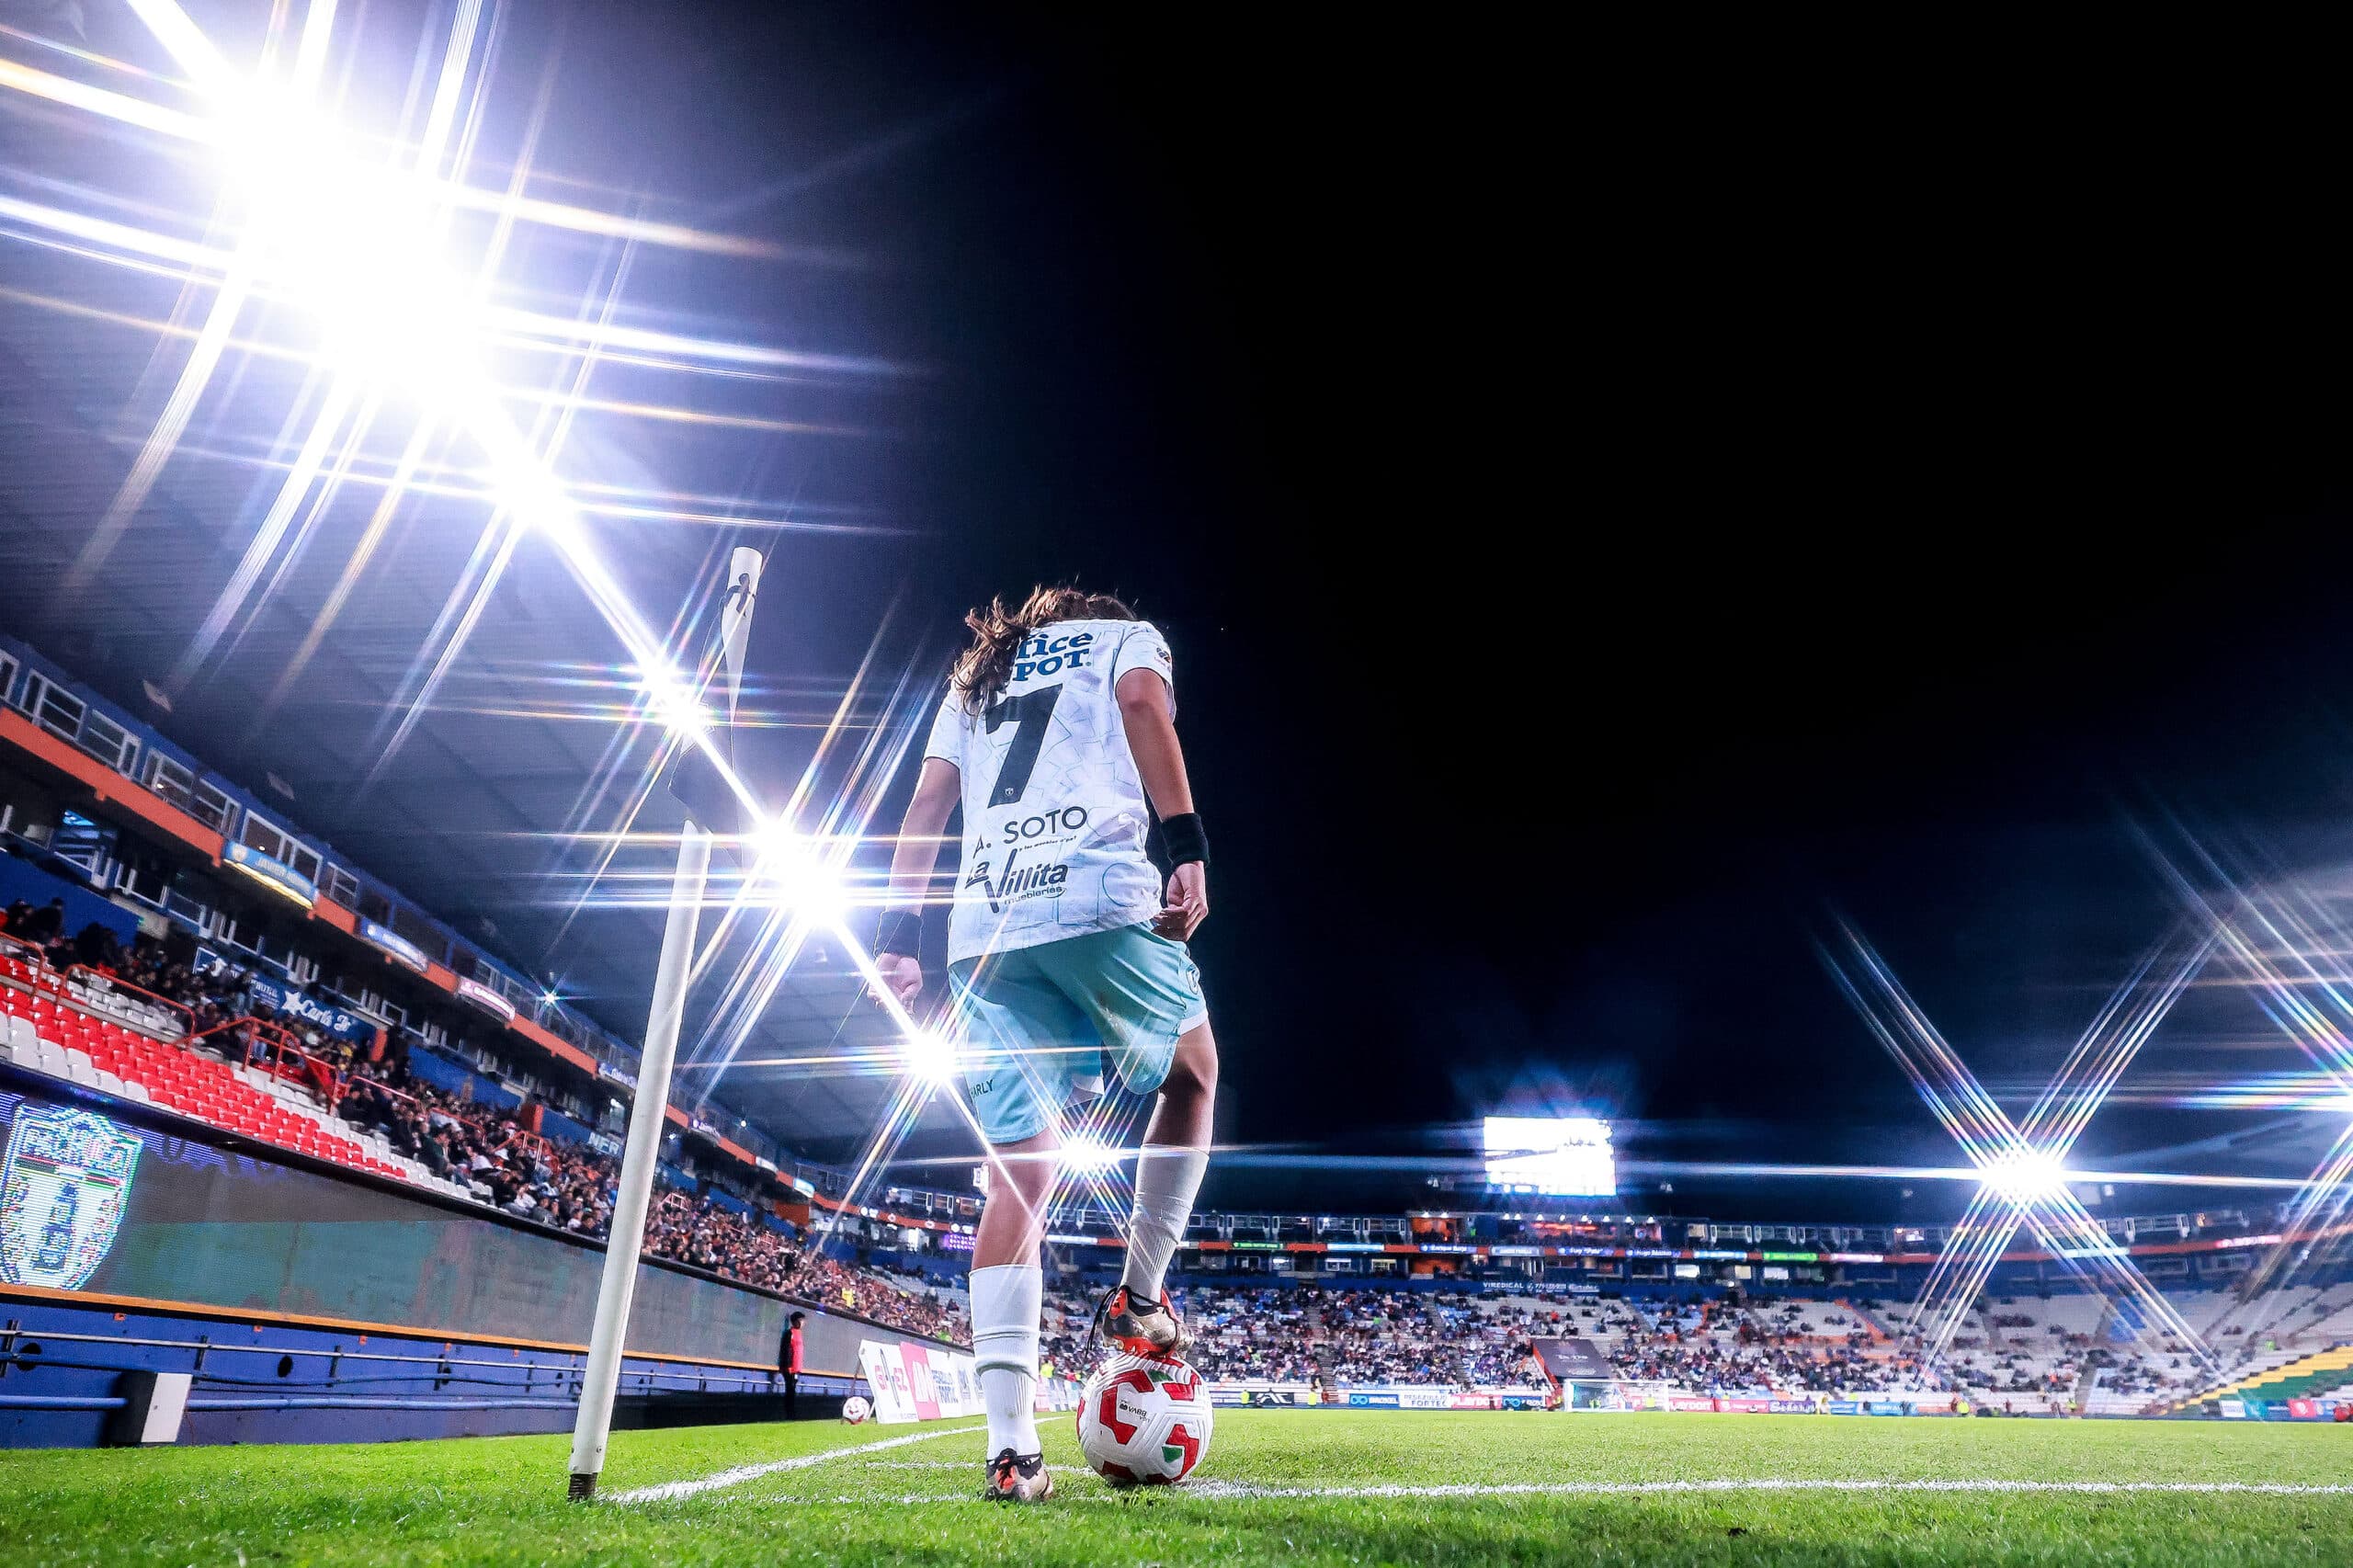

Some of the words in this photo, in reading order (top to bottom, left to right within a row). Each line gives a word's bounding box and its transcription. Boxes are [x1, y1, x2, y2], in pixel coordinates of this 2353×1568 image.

[1016, 631, 1093, 660] fice
[1012, 648, 1090, 682] POT
[984, 684, 1063, 808] 7
[1004, 806, 1087, 845] SOTO
[965, 860, 990, 890] La
[984, 847, 1068, 914] Villita
[1128, 1406, 1147, 1417] BBVA
[1453, 1396, 1500, 1407] PLAYDOT
